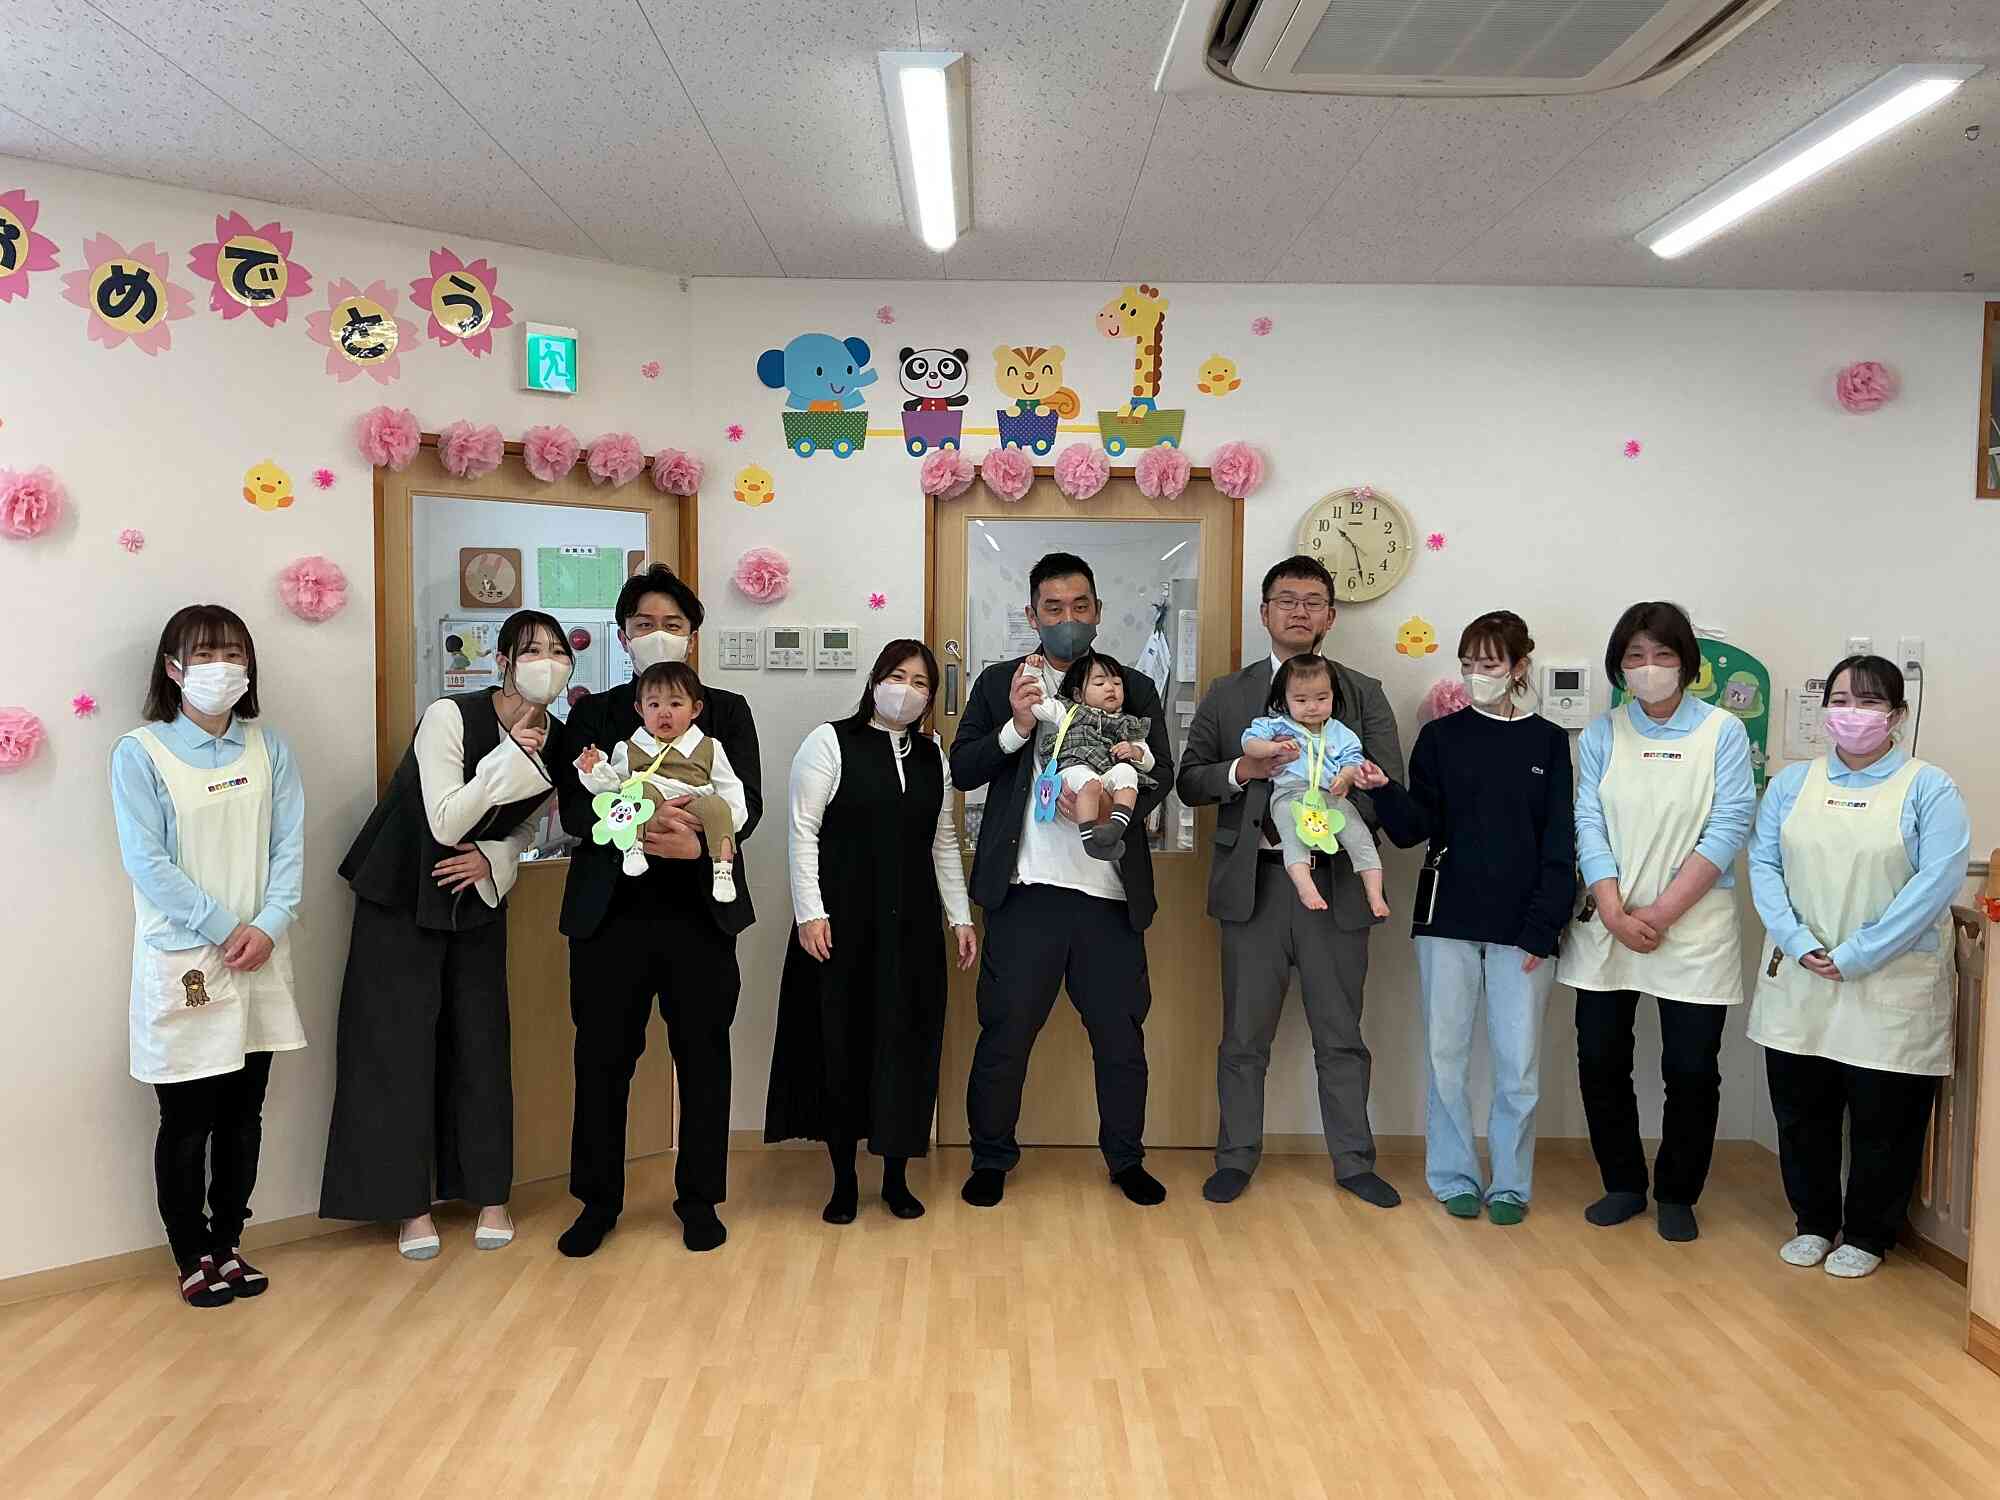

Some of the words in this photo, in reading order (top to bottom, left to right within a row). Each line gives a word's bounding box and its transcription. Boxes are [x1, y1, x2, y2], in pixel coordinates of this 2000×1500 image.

[1333, 506, 1342, 519] 11
[1351, 502, 1363, 515] 12
[1372, 507, 1378, 520] 1
[1318, 519, 1330, 532] 10
[1383, 521, 1392, 534] 2
[1312, 538, 1321, 550] 9
[1387, 540, 1396, 553] 3
[1379, 558, 1388, 571] 4
[1347, 576, 1356, 589] 6
[1366, 573, 1375, 585] 5
